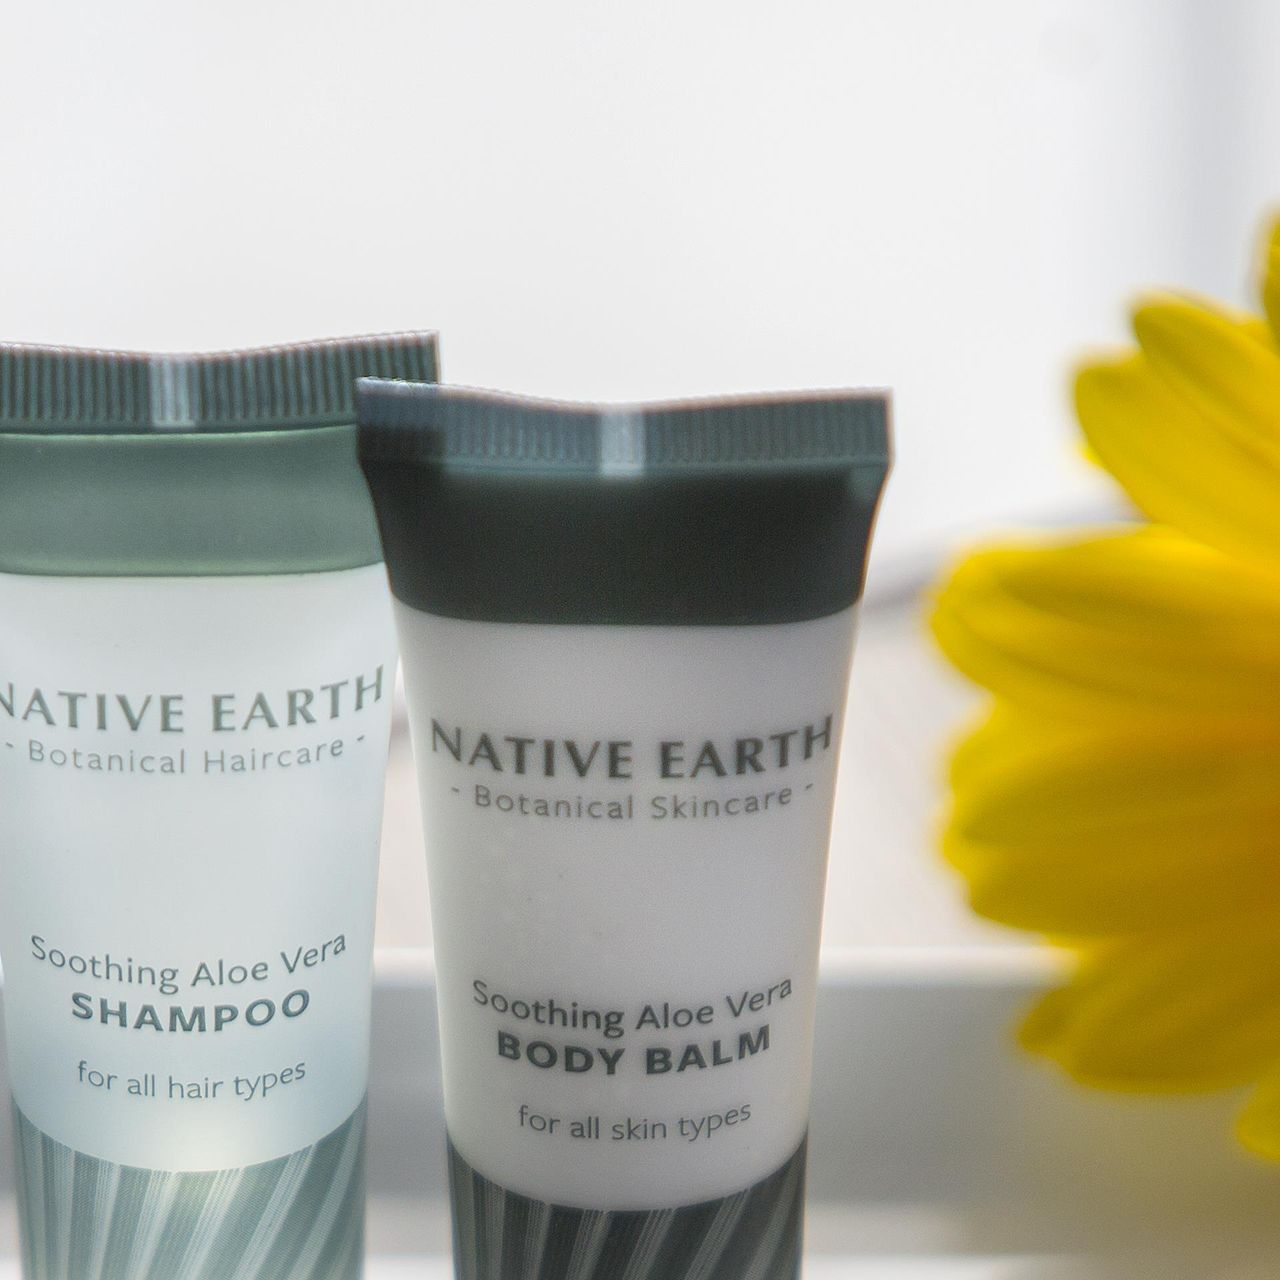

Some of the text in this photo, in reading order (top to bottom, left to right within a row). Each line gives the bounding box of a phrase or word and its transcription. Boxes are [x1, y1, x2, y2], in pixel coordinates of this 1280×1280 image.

[212, 665, 384, 733] EARTH
[29, 740, 185, 773] Botanical
[204, 738, 344, 773] Haircare
[431, 714, 835, 778] NATIVE EARTH
[475, 785, 634, 819] Botanical
[651, 787, 792, 819] Skincare
[31, 934, 347, 995] Soothing Aloe Vera
[71, 989, 310, 1033] SHAMPOO
[473, 978, 793, 1039] Soothing Aloe Vera
[497, 1024, 771, 1075] BODY BALM
[78, 1061, 306, 1101] for all hair types
[519, 1104, 752, 1142] for all skin types
